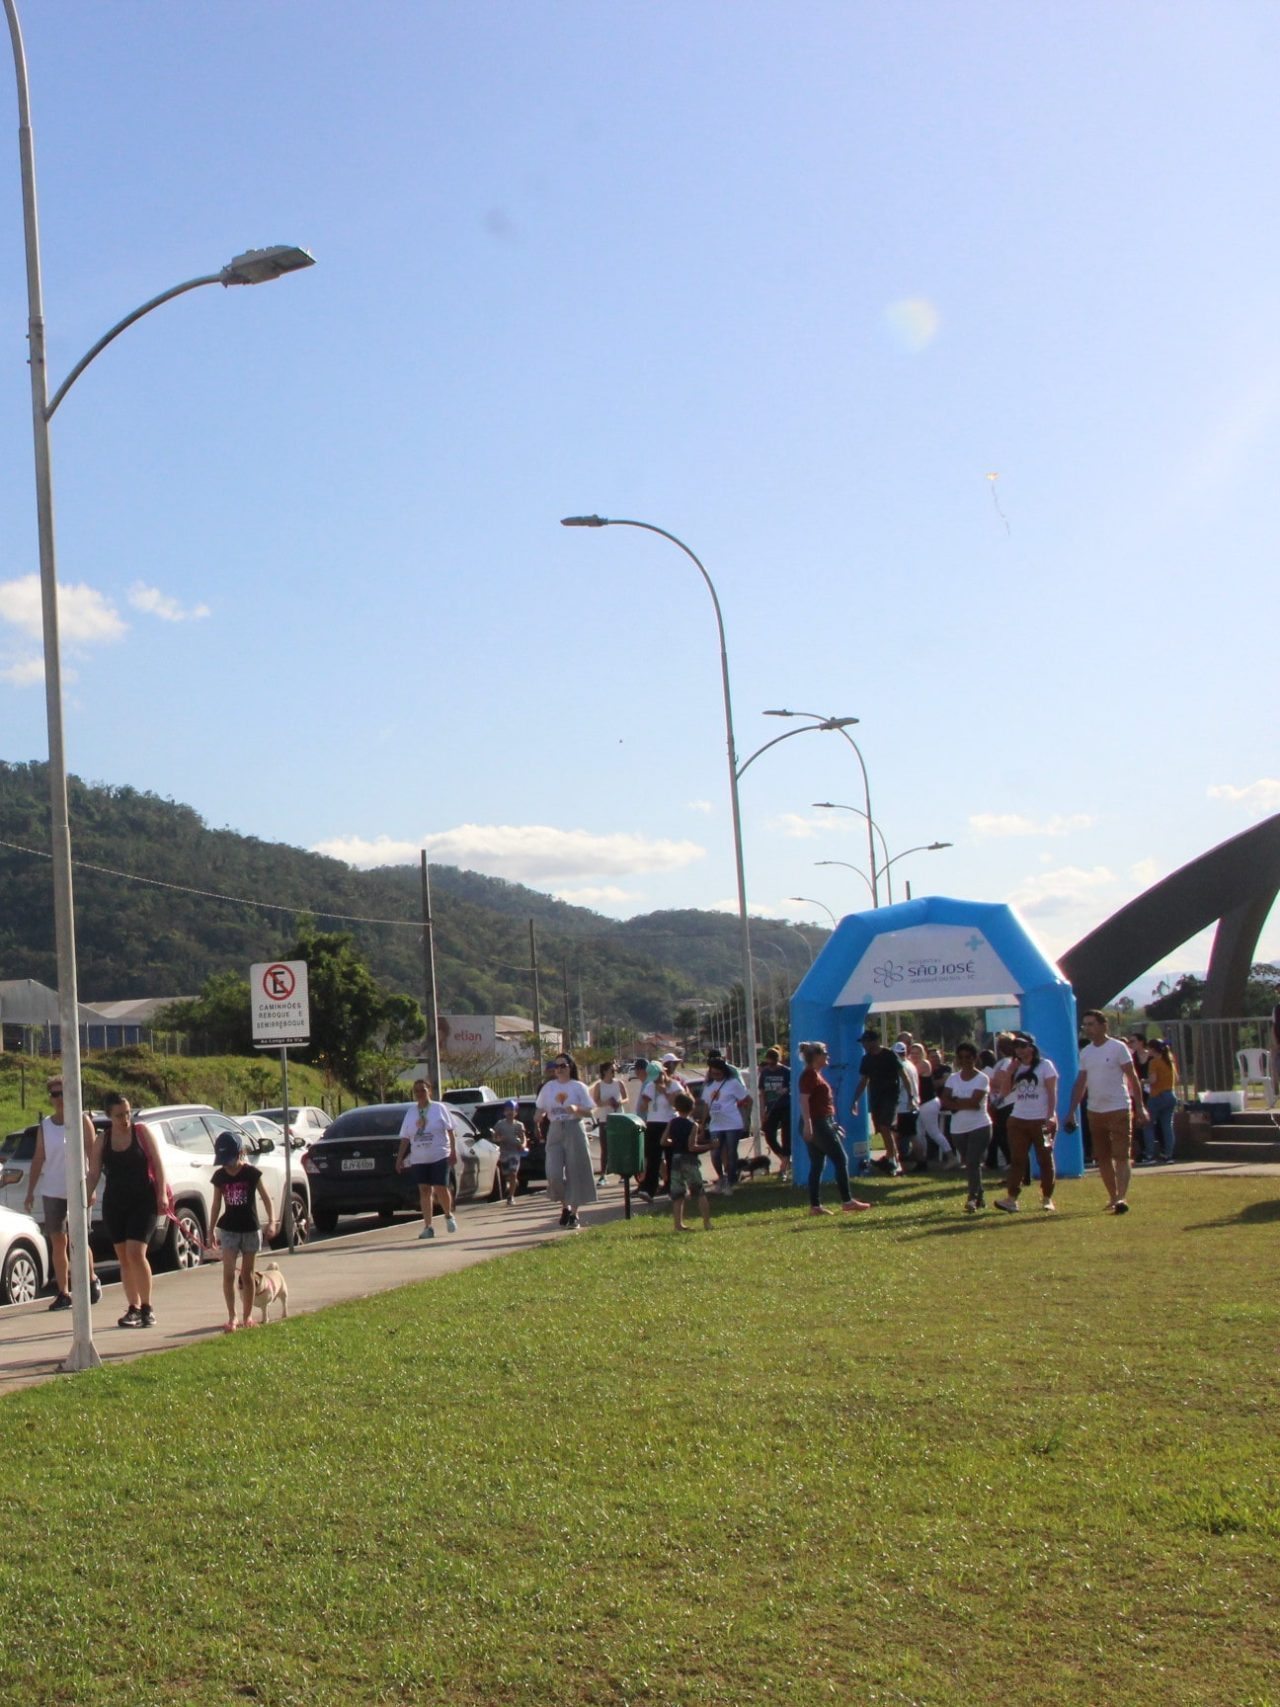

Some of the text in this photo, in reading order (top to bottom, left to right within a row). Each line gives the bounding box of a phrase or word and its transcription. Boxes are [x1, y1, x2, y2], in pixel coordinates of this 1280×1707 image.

[908, 960, 975, 976] SÃO JOSÉ
[259, 1002, 302, 1011] CAMINHÕES
[454, 1030, 482, 1041] elian
